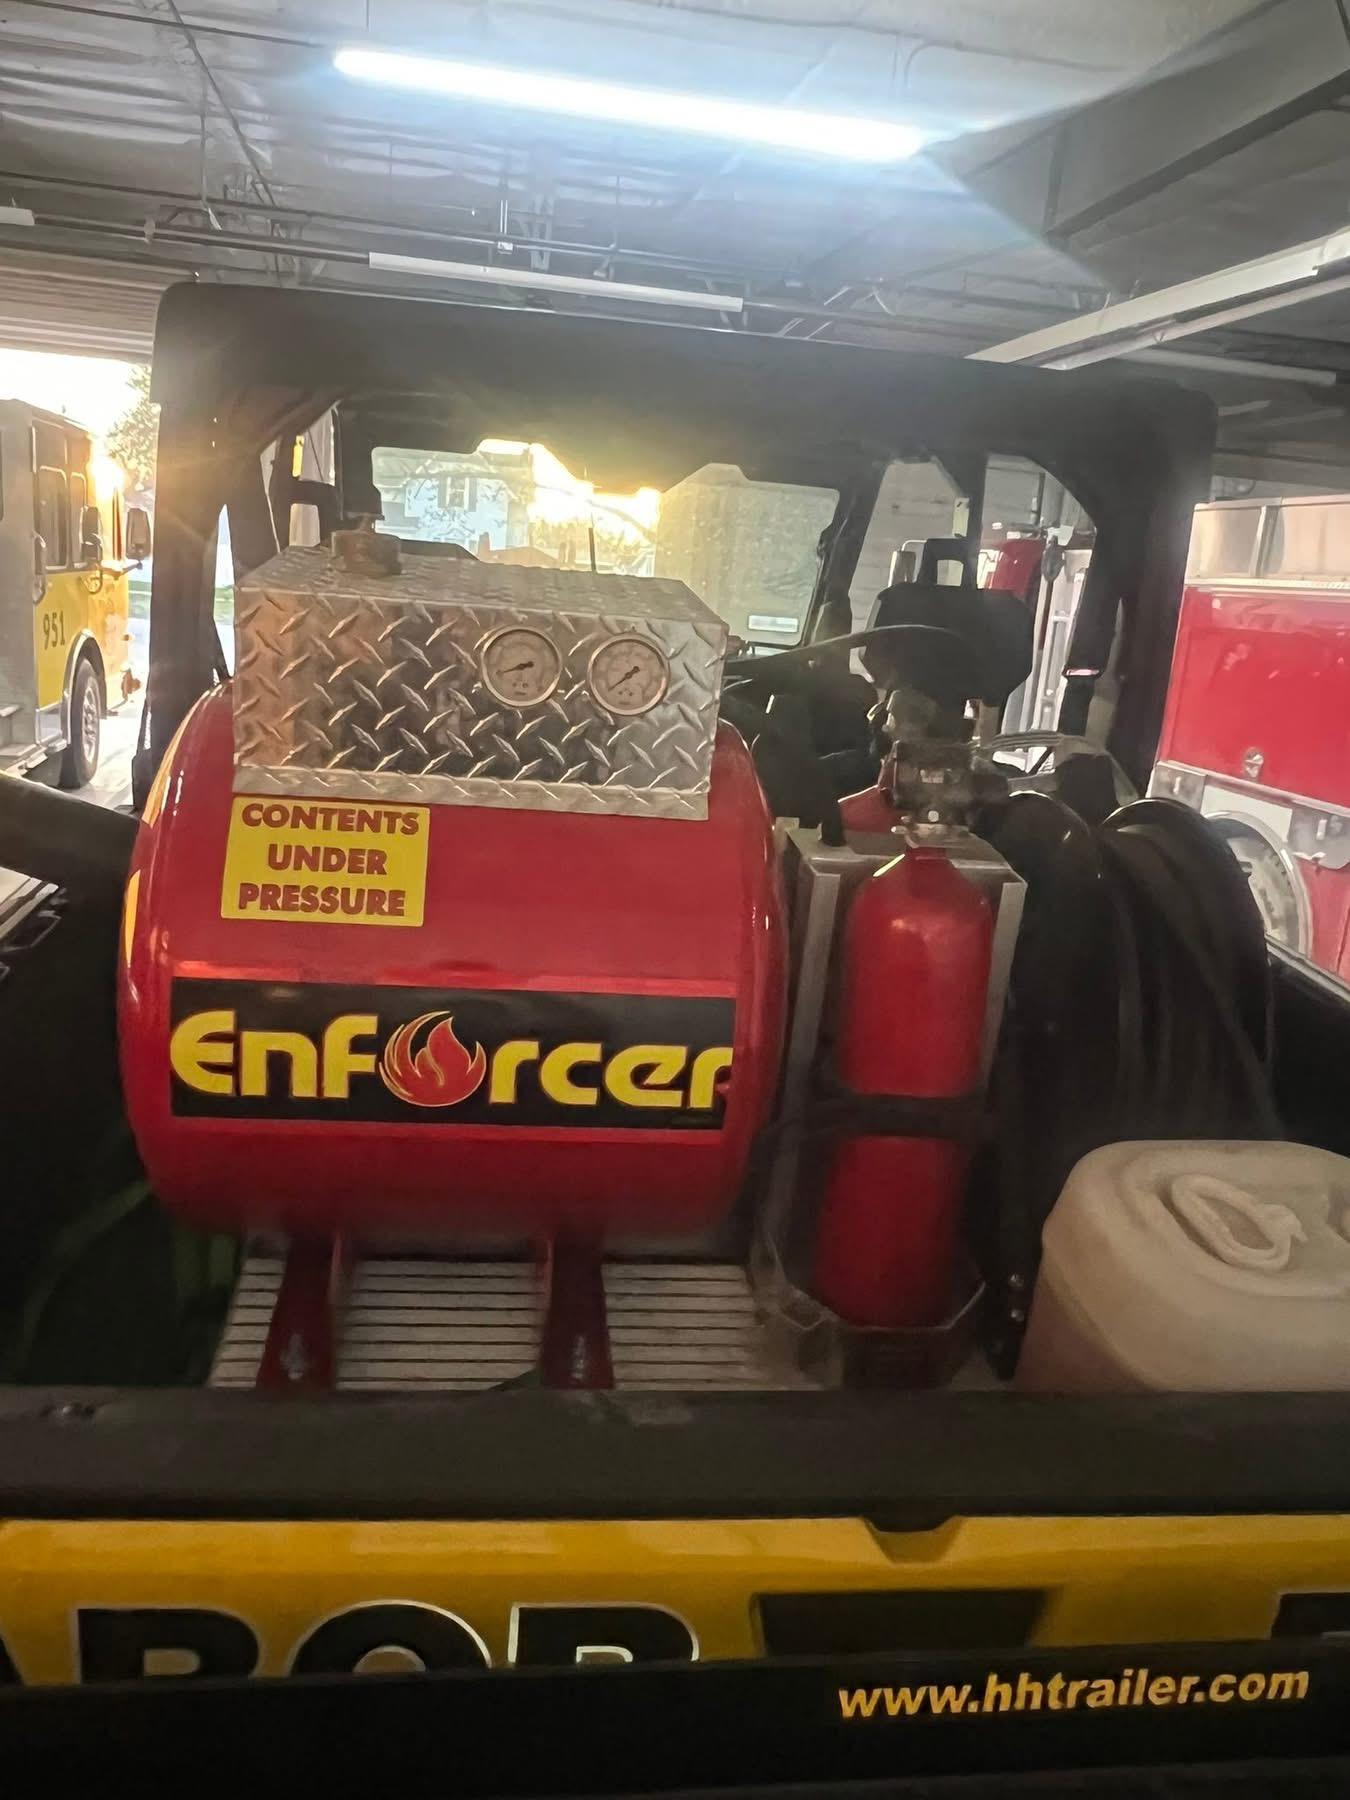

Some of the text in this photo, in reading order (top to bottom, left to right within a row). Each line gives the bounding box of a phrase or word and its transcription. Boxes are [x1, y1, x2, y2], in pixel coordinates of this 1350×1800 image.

[43, 610, 65, 650] 951
[241, 803, 420, 836] CONTENTS
[267, 843, 387, 877] UNDER
[238, 883, 406, 916] PRESSURE
[838, 1667, 1310, 1720] www.hhtrailer.com
